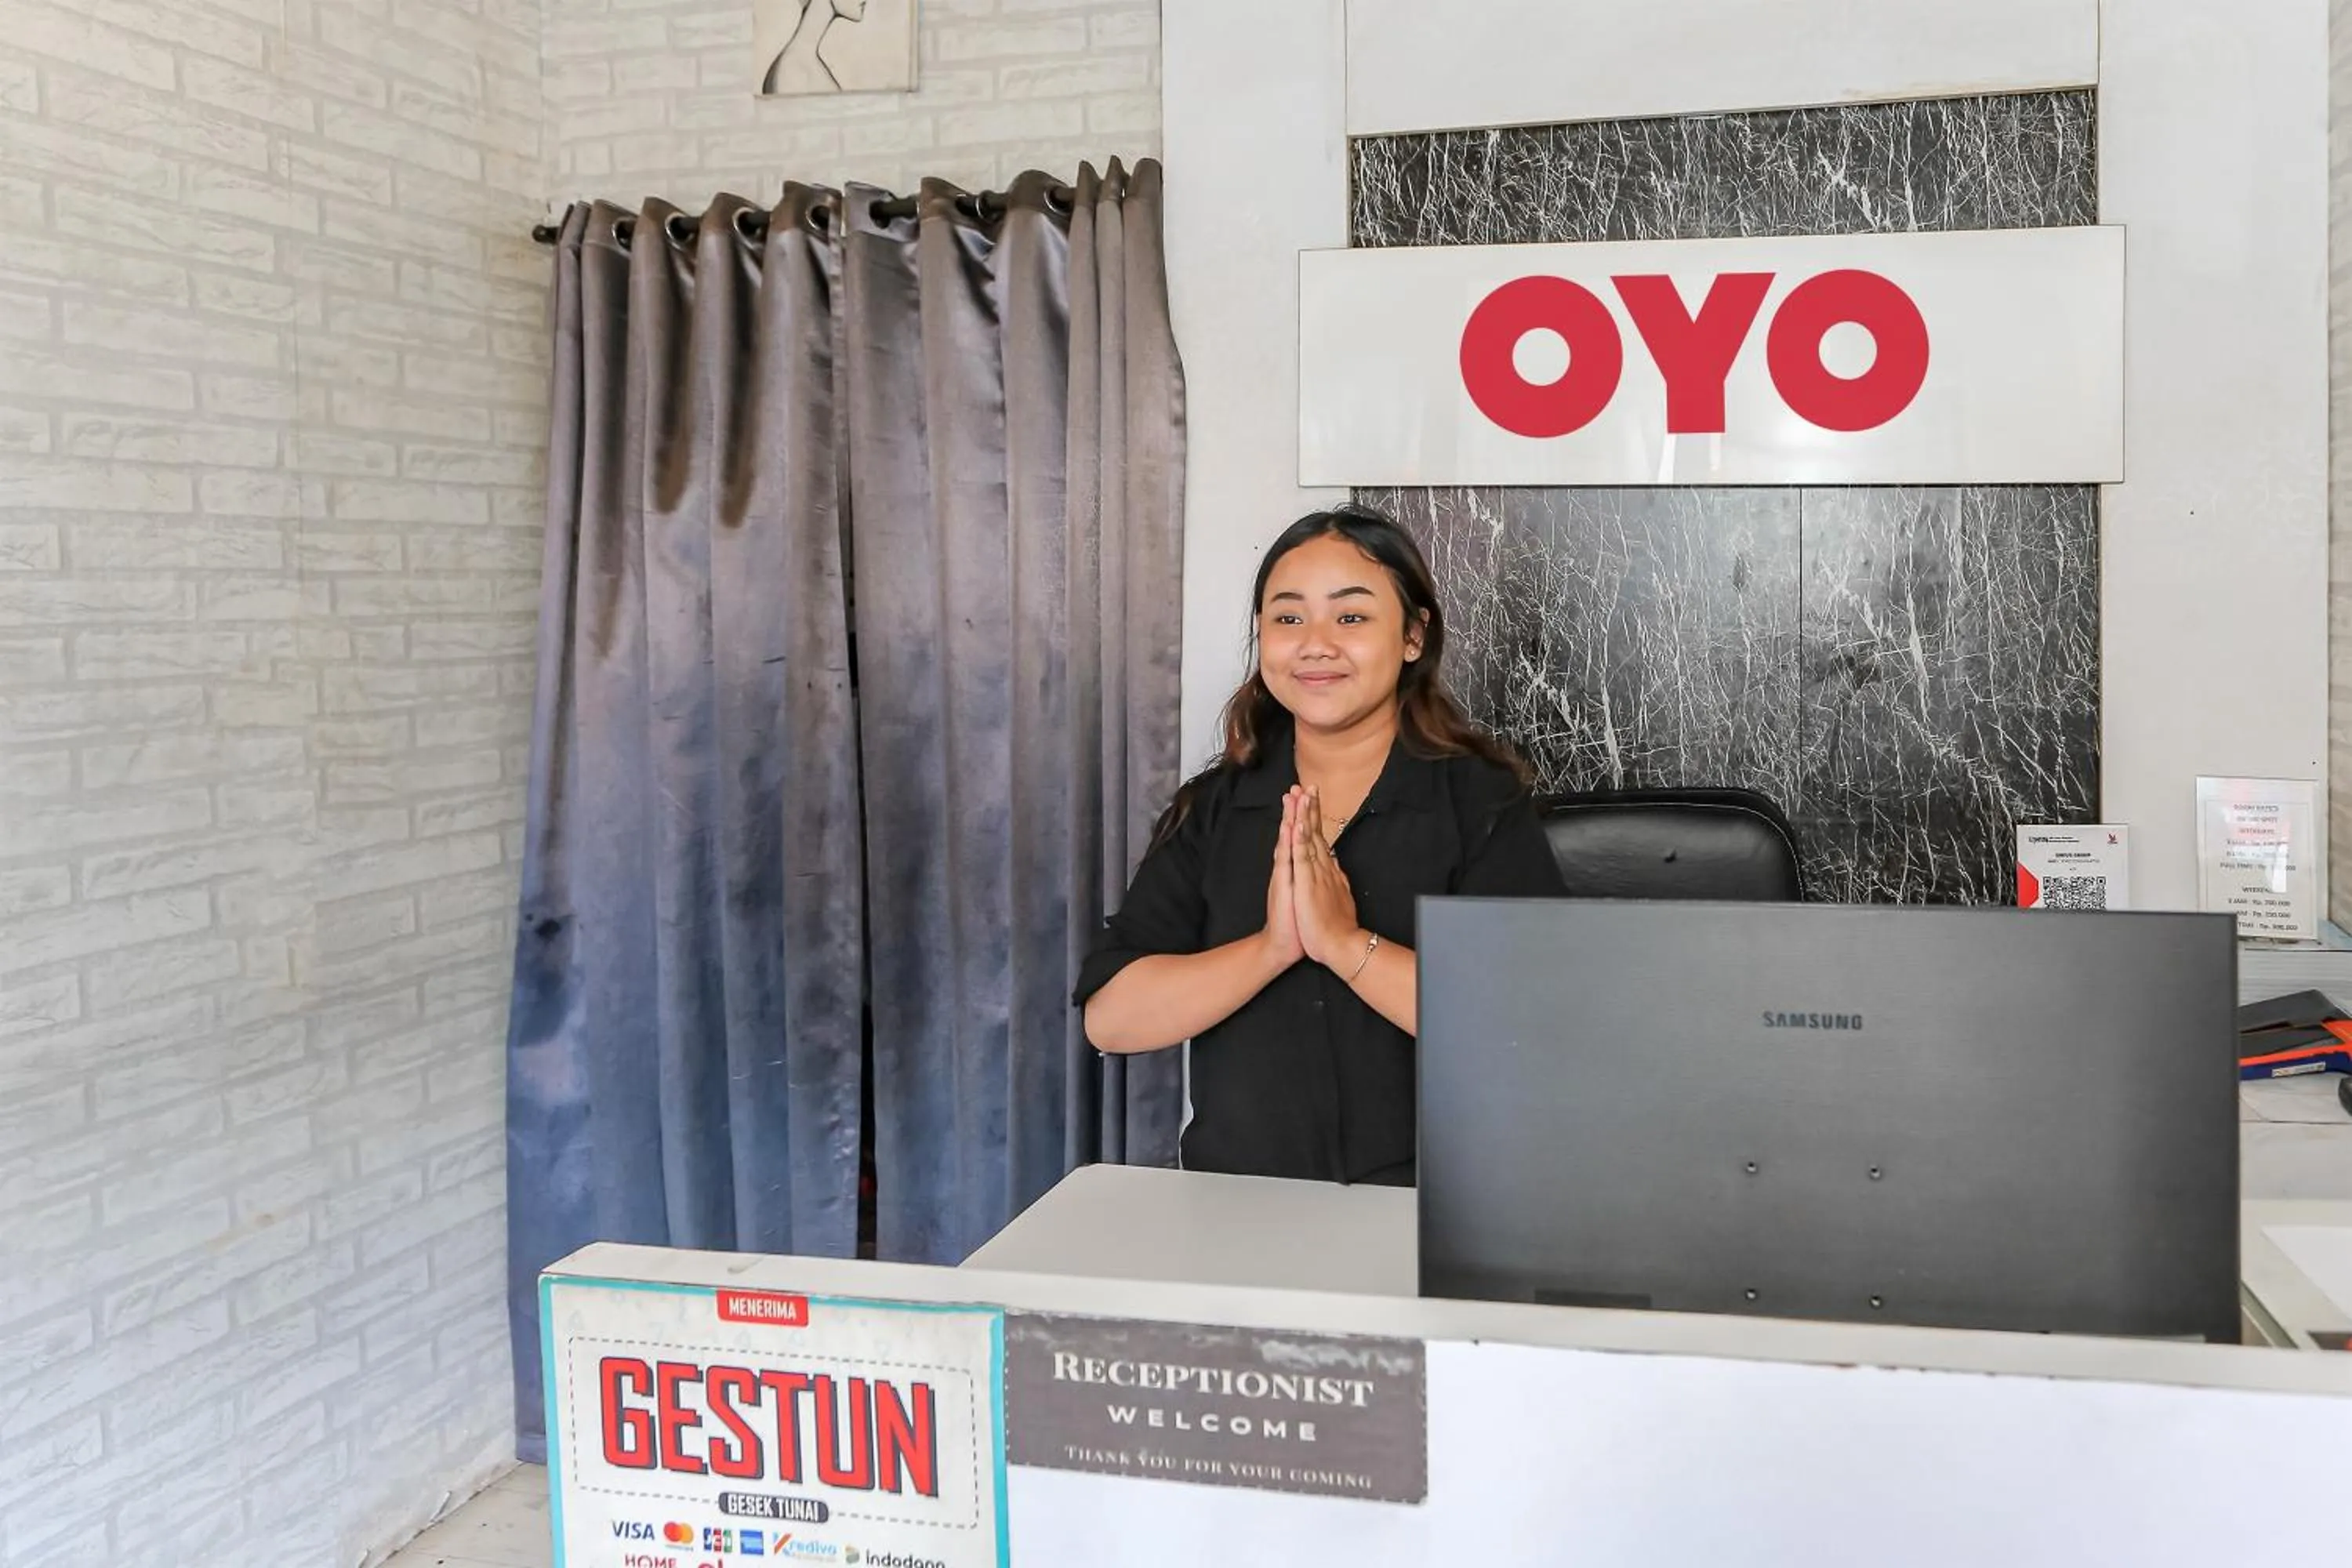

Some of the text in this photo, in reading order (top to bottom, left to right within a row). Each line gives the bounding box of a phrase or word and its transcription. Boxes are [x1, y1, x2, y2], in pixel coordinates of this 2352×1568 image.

[1460, 269, 1929, 437] OYO
[1762, 1011, 1863, 1030] SAMSUNG
[728, 1297, 797, 1320] MENERIMA
[1053, 1351, 1374, 1407] RECEPTIONIST
[600, 1356, 939, 1498] GESTUN
[1107, 1405, 1316, 1441] WELCOME
[1065, 1445, 1372, 1489] THANK YOU FOR YOUR COMING
[728, 1493, 820, 1522] GESEK TUNAI
[612, 1519, 655, 1541] VISA
